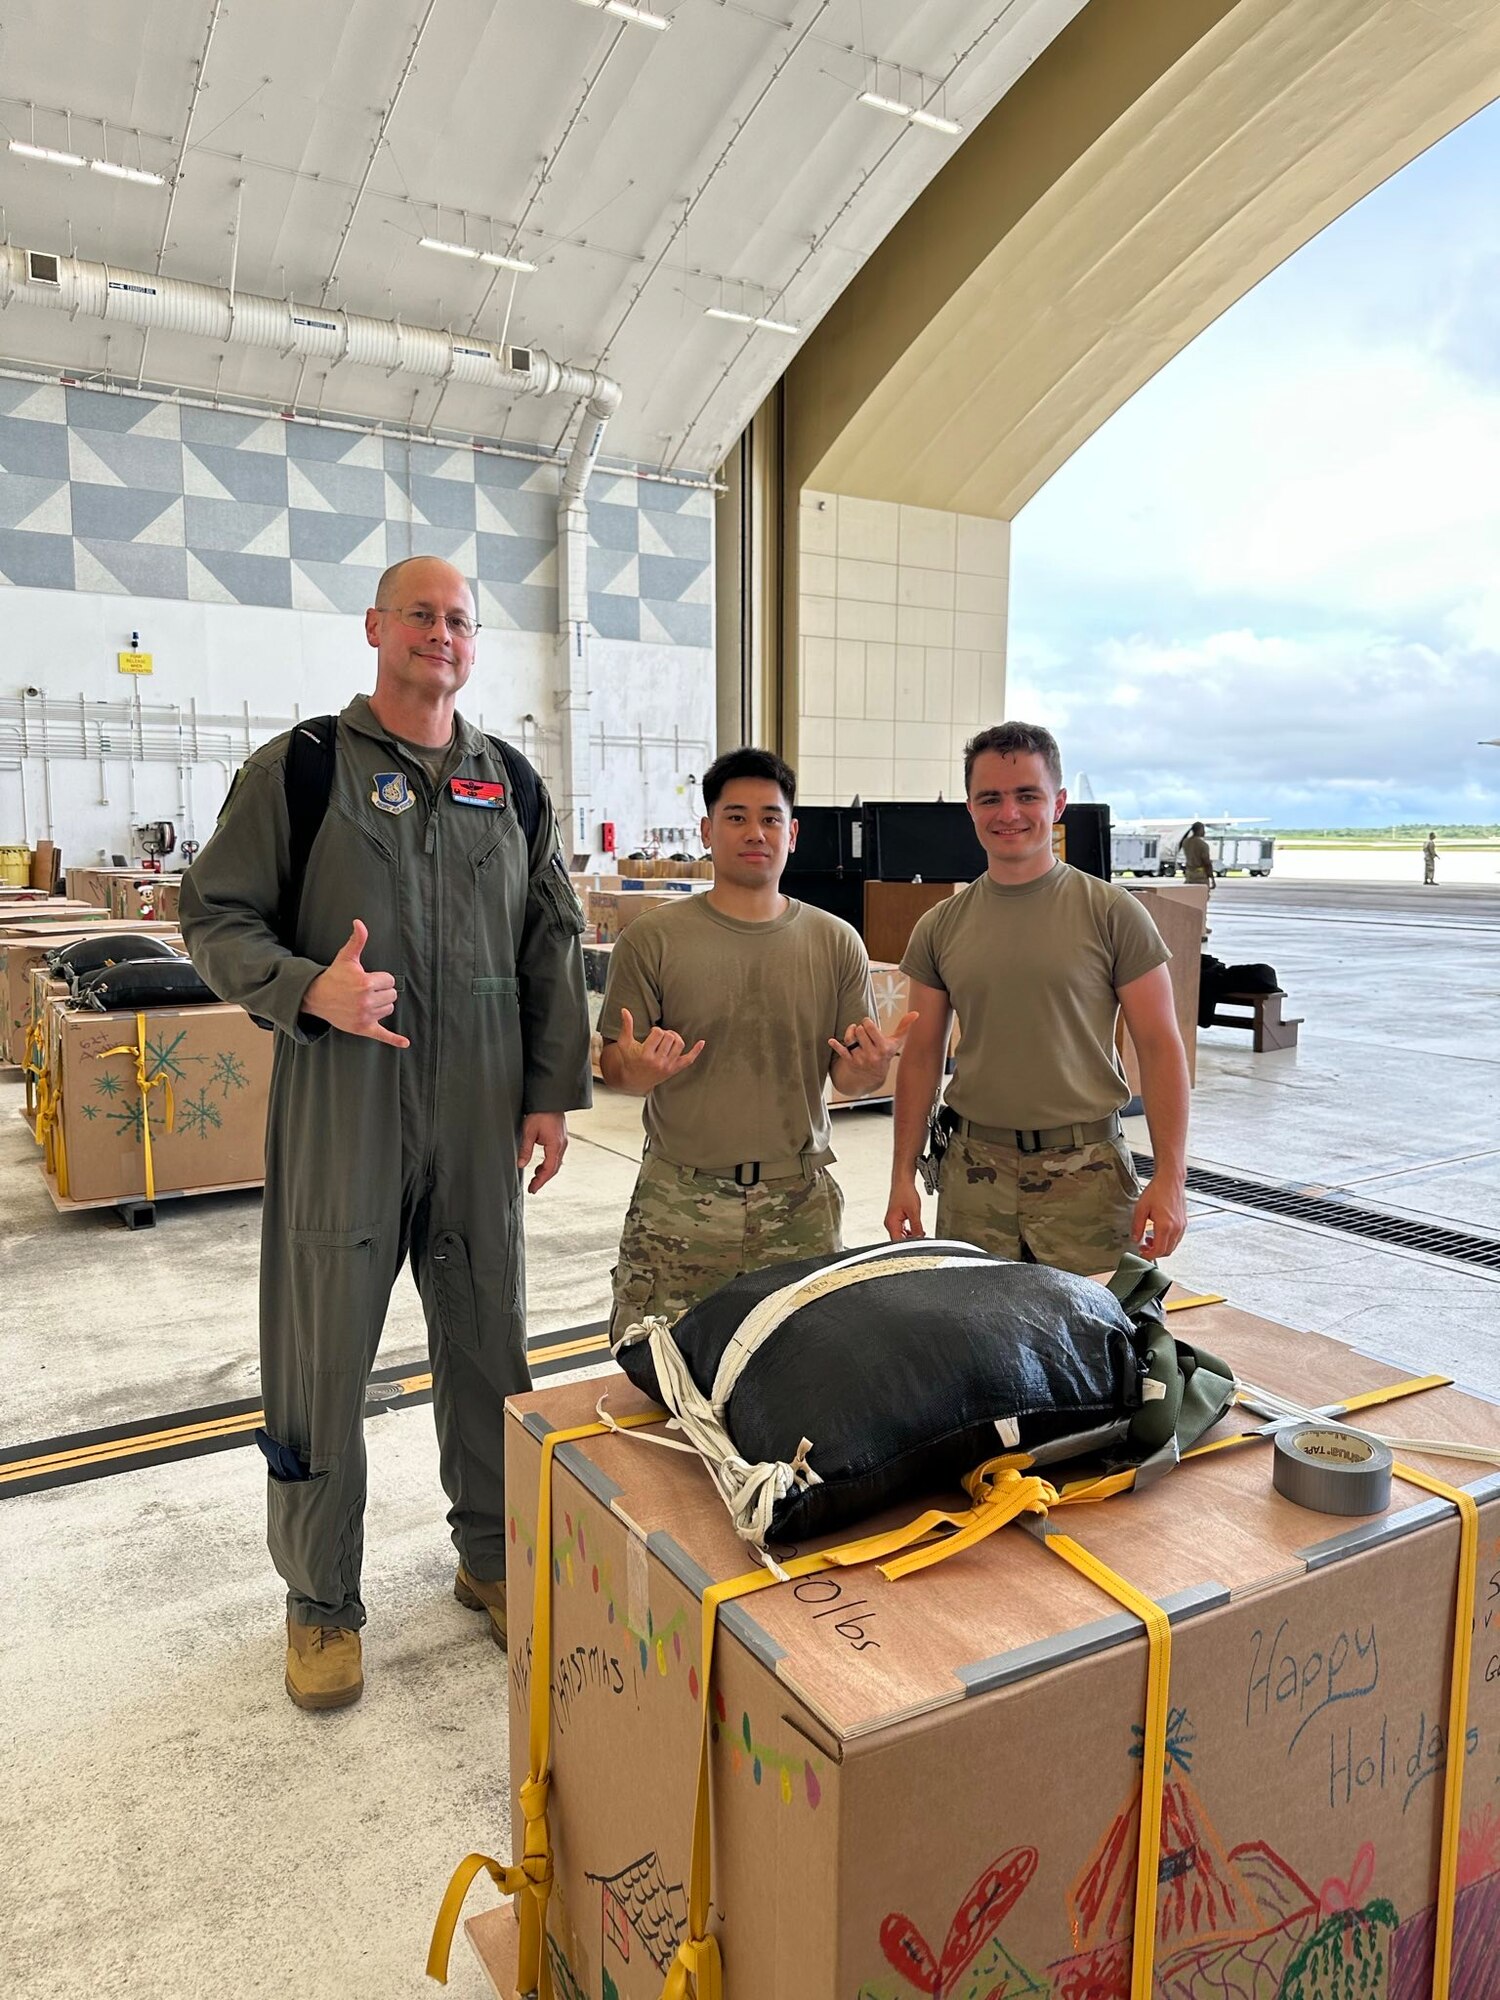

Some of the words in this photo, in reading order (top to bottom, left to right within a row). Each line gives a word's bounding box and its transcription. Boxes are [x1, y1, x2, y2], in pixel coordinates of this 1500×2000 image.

[1304, 1446, 1326, 1455] TAPE
[1246, 1619, 1379, 1756] Happy
[1329, 1712, 1479, 1815] Holidas
